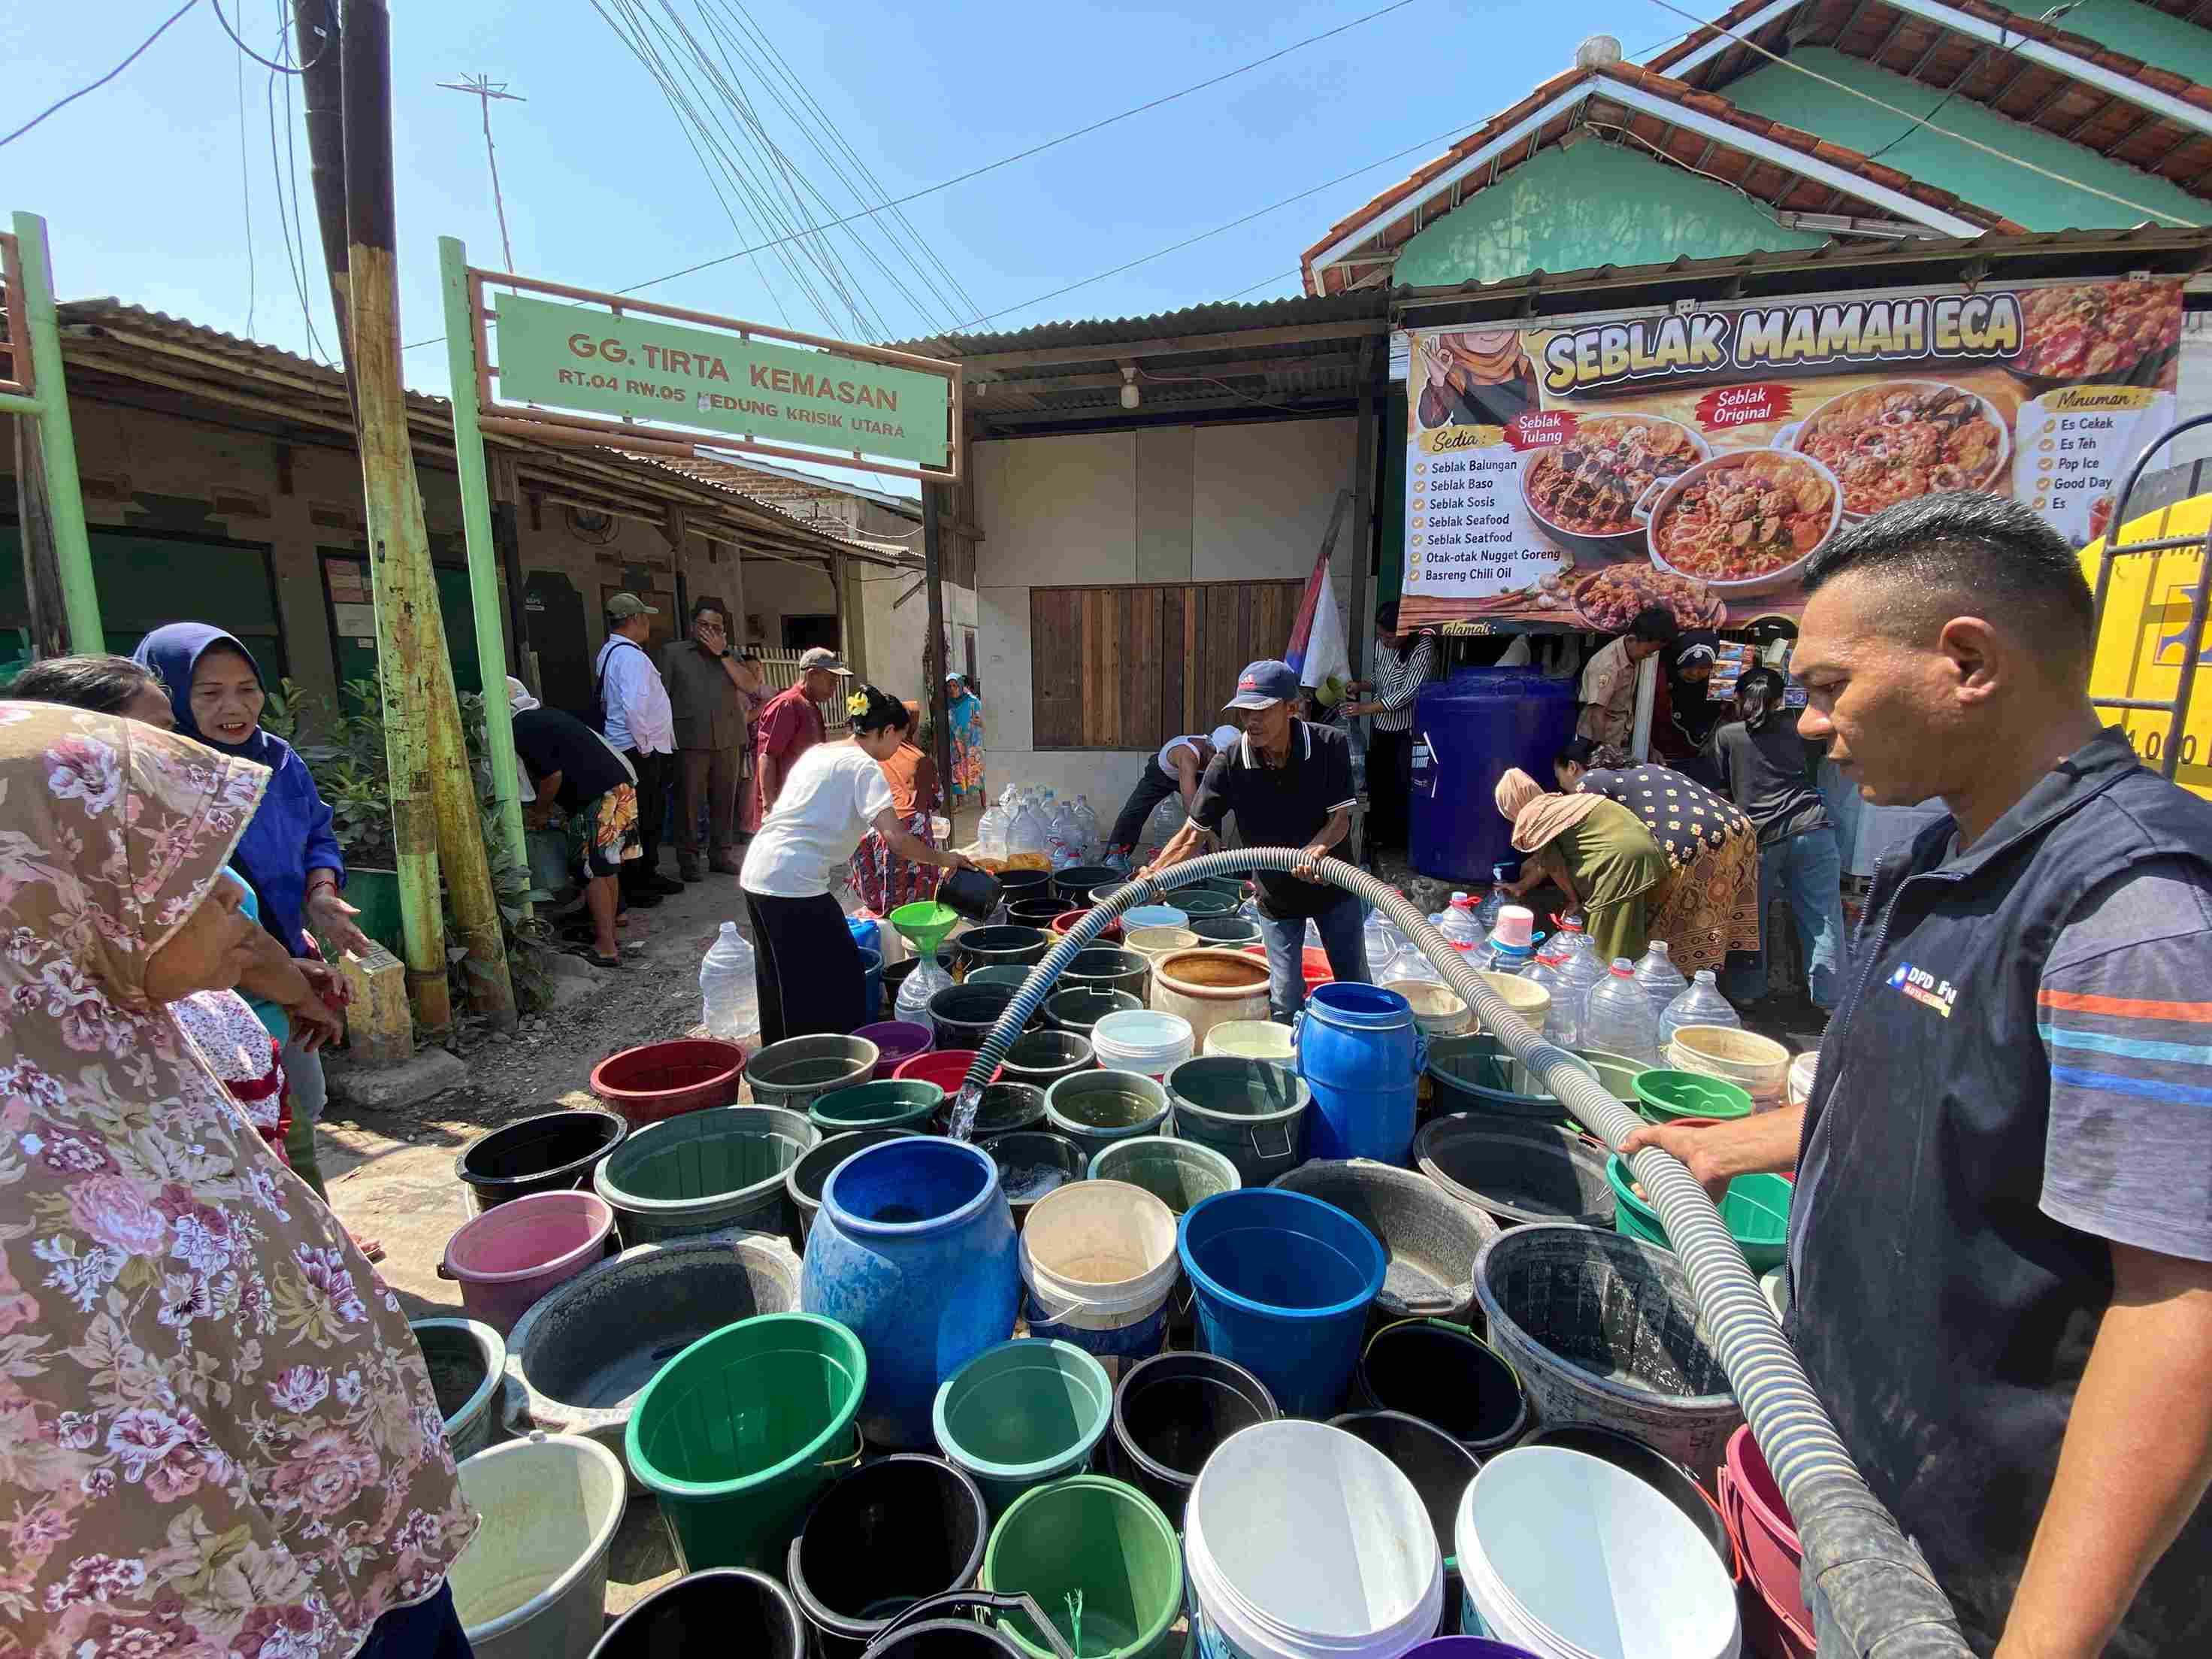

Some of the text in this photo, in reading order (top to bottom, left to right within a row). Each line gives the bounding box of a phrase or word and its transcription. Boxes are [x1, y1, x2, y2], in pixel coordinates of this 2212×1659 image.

[1546, 312, 1729, 392] SEBLAK
[1737, 298, 1927, 367] MAMAH
[568, 333, 897, 412] GG. TIRTA KEMASAN
[558, 368, 619, 392] RT.04
[625, 379, 686, 402] RW.05
[785, 406, 843, 427] KRISIK
[851, 417, 906, 438] UTARA
[1717, 386, 1766, 407] Seblak
[2056, 390, 2130, 408] Minuman
[1519, 413, 1562, 429] Seblak
[1714, 403, 1772, 424] Original
[2061, 419, 2075, 431] Es
[1432, 429, 1478, 451] Sedia
[1521, 430, 1563, 444] Tulang
[2060, 437, 2096, 450] Es Teh
[1431, 459, 1517, 474] Seblak Balungan
[2058, 457, 2099, 472] Pop Ice
[1430, 479, 1493, 491] Seblak Baso
[2054, 477, 2114, 490] Good Day
[1430, 496, 1496, 510] Seblak Sosis
[2052, 497, 2066, 509] Es
[1429, 513, 1510, 528] Seblak Seafood
[1427, 531, 1513, 545] Seblak Seatfood
[1427, 549, 1560, 563] Otak-otak Nugget Goreng
[1425, 568, 1511, 582] Basreng Chili Oil
[1906, 967, 1935, 989] DPD
